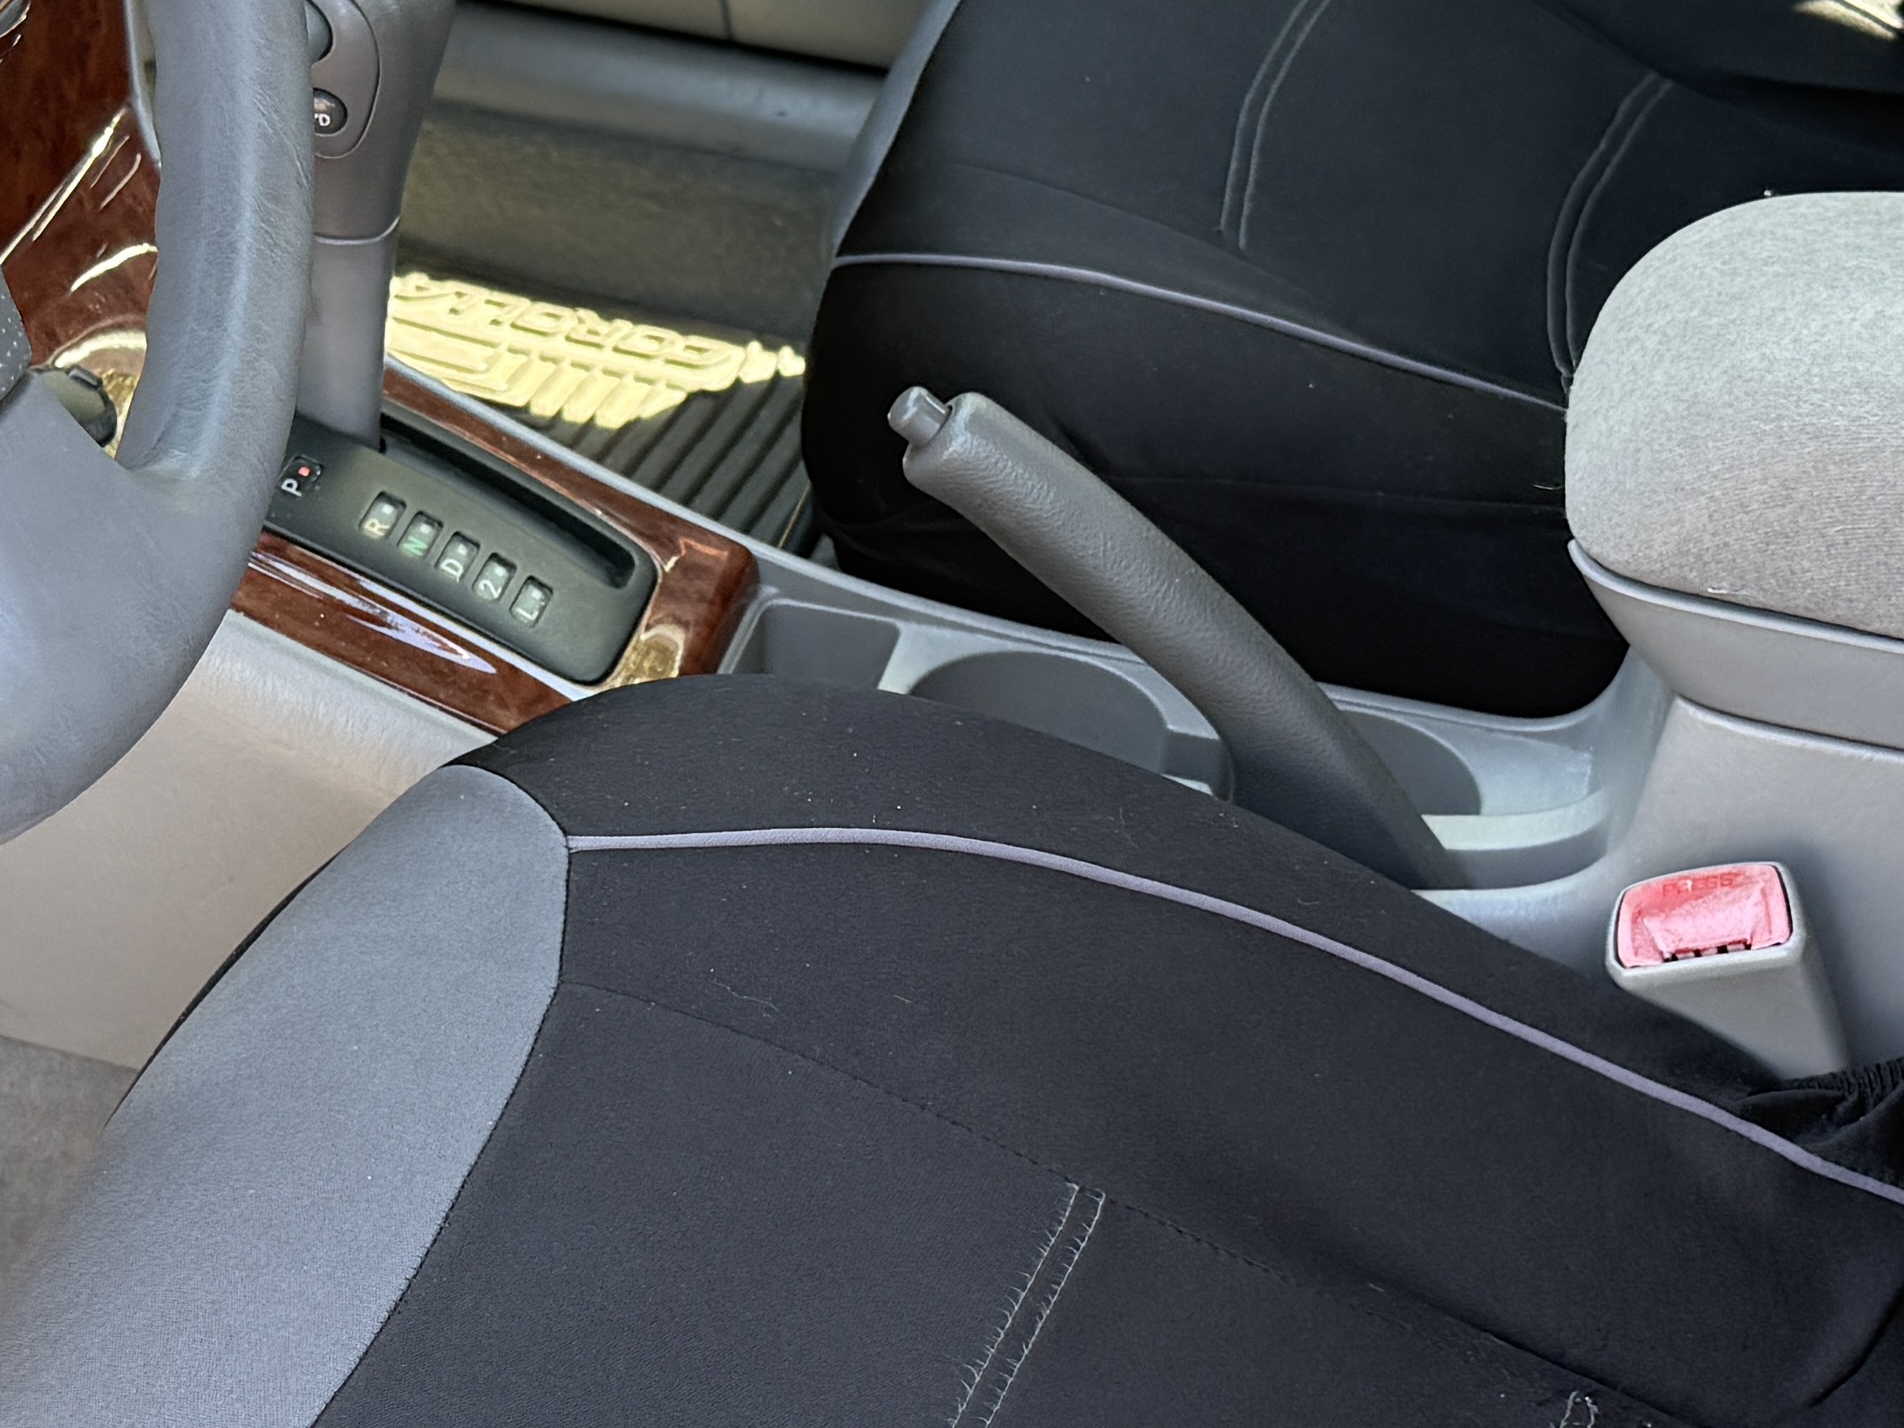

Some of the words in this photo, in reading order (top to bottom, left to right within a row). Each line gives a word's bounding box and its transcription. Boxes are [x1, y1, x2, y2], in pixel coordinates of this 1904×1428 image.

[281, 478, 302, 497] P
[363, 517, 391, 537] R
[403, 535, 429, 556] N
[440, 558, 465, 583] D
[478, 580, 503, 599] 2
[516, 607, 540, 621] L
[1661, 872, 1735, 897] PRESS
